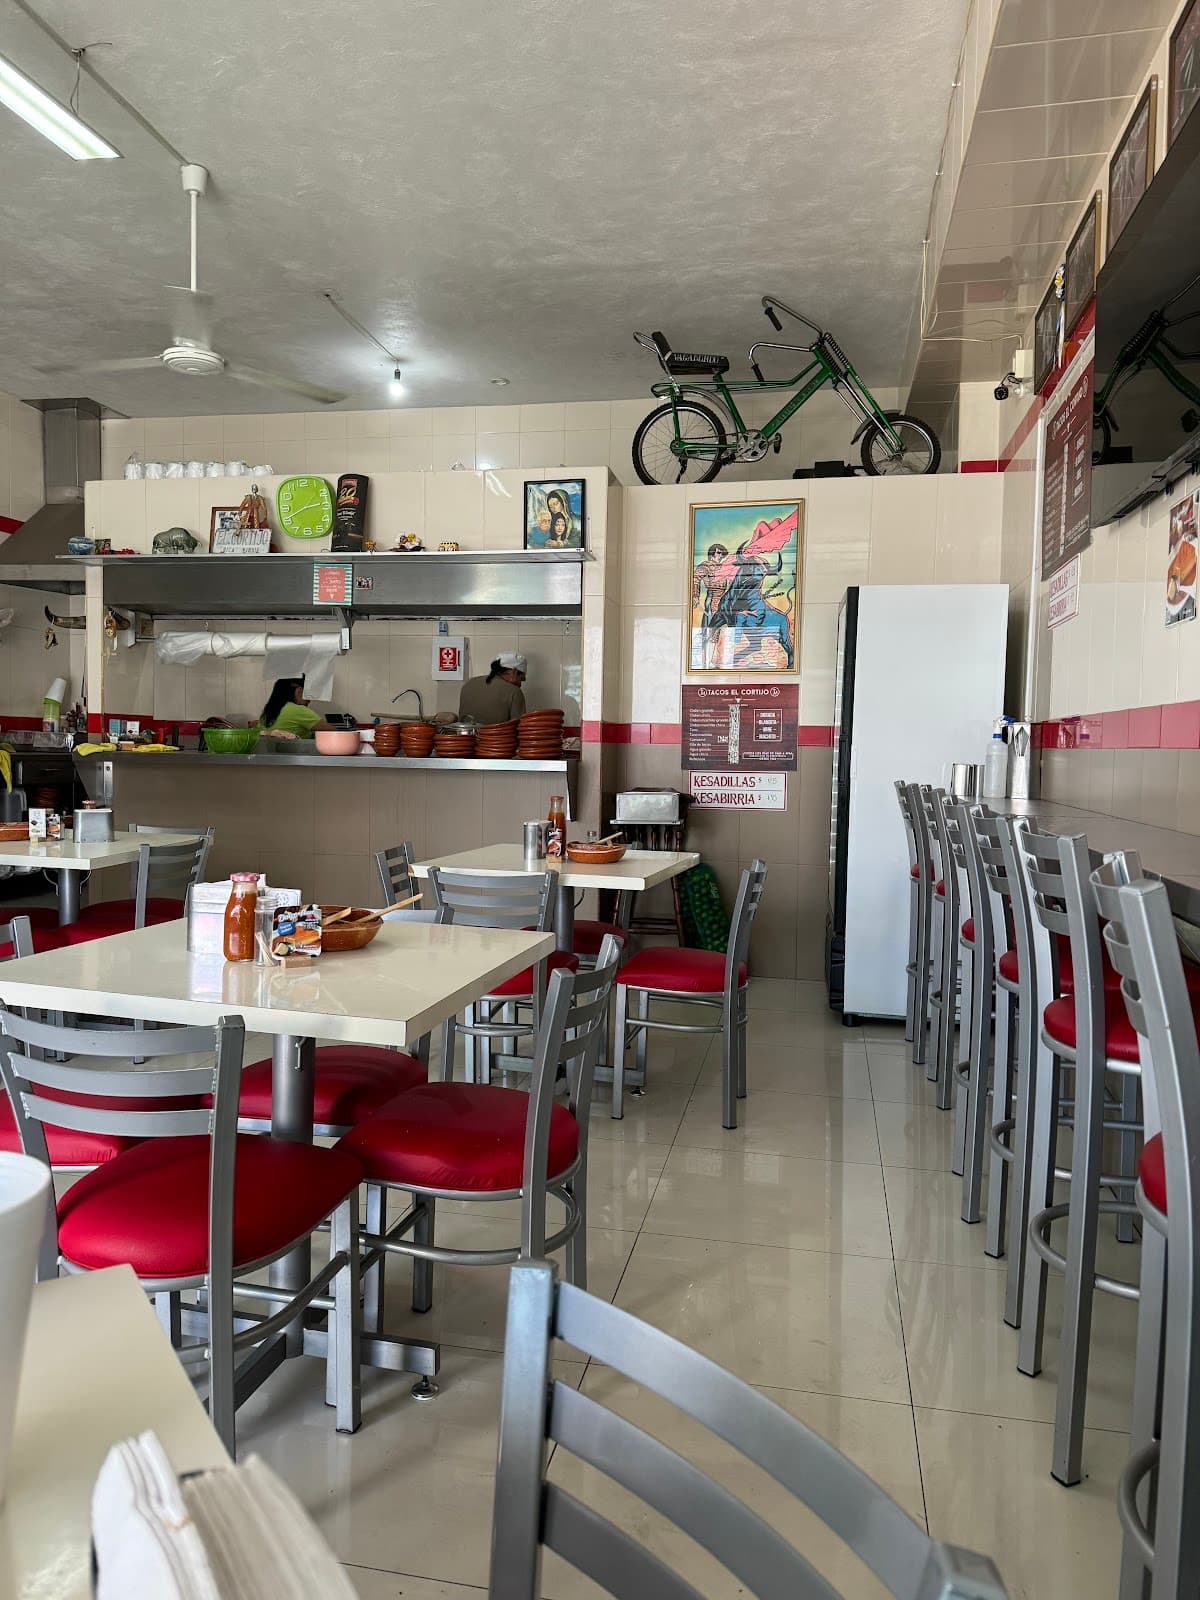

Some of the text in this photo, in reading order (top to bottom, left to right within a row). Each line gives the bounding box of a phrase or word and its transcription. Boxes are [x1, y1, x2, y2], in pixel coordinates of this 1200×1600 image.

[673, 353, 720, 363] VAGABUNDO
[693, 775, 756, 788] KESADILLAS
[693, 792, 755, 805] KESABIRRIA
